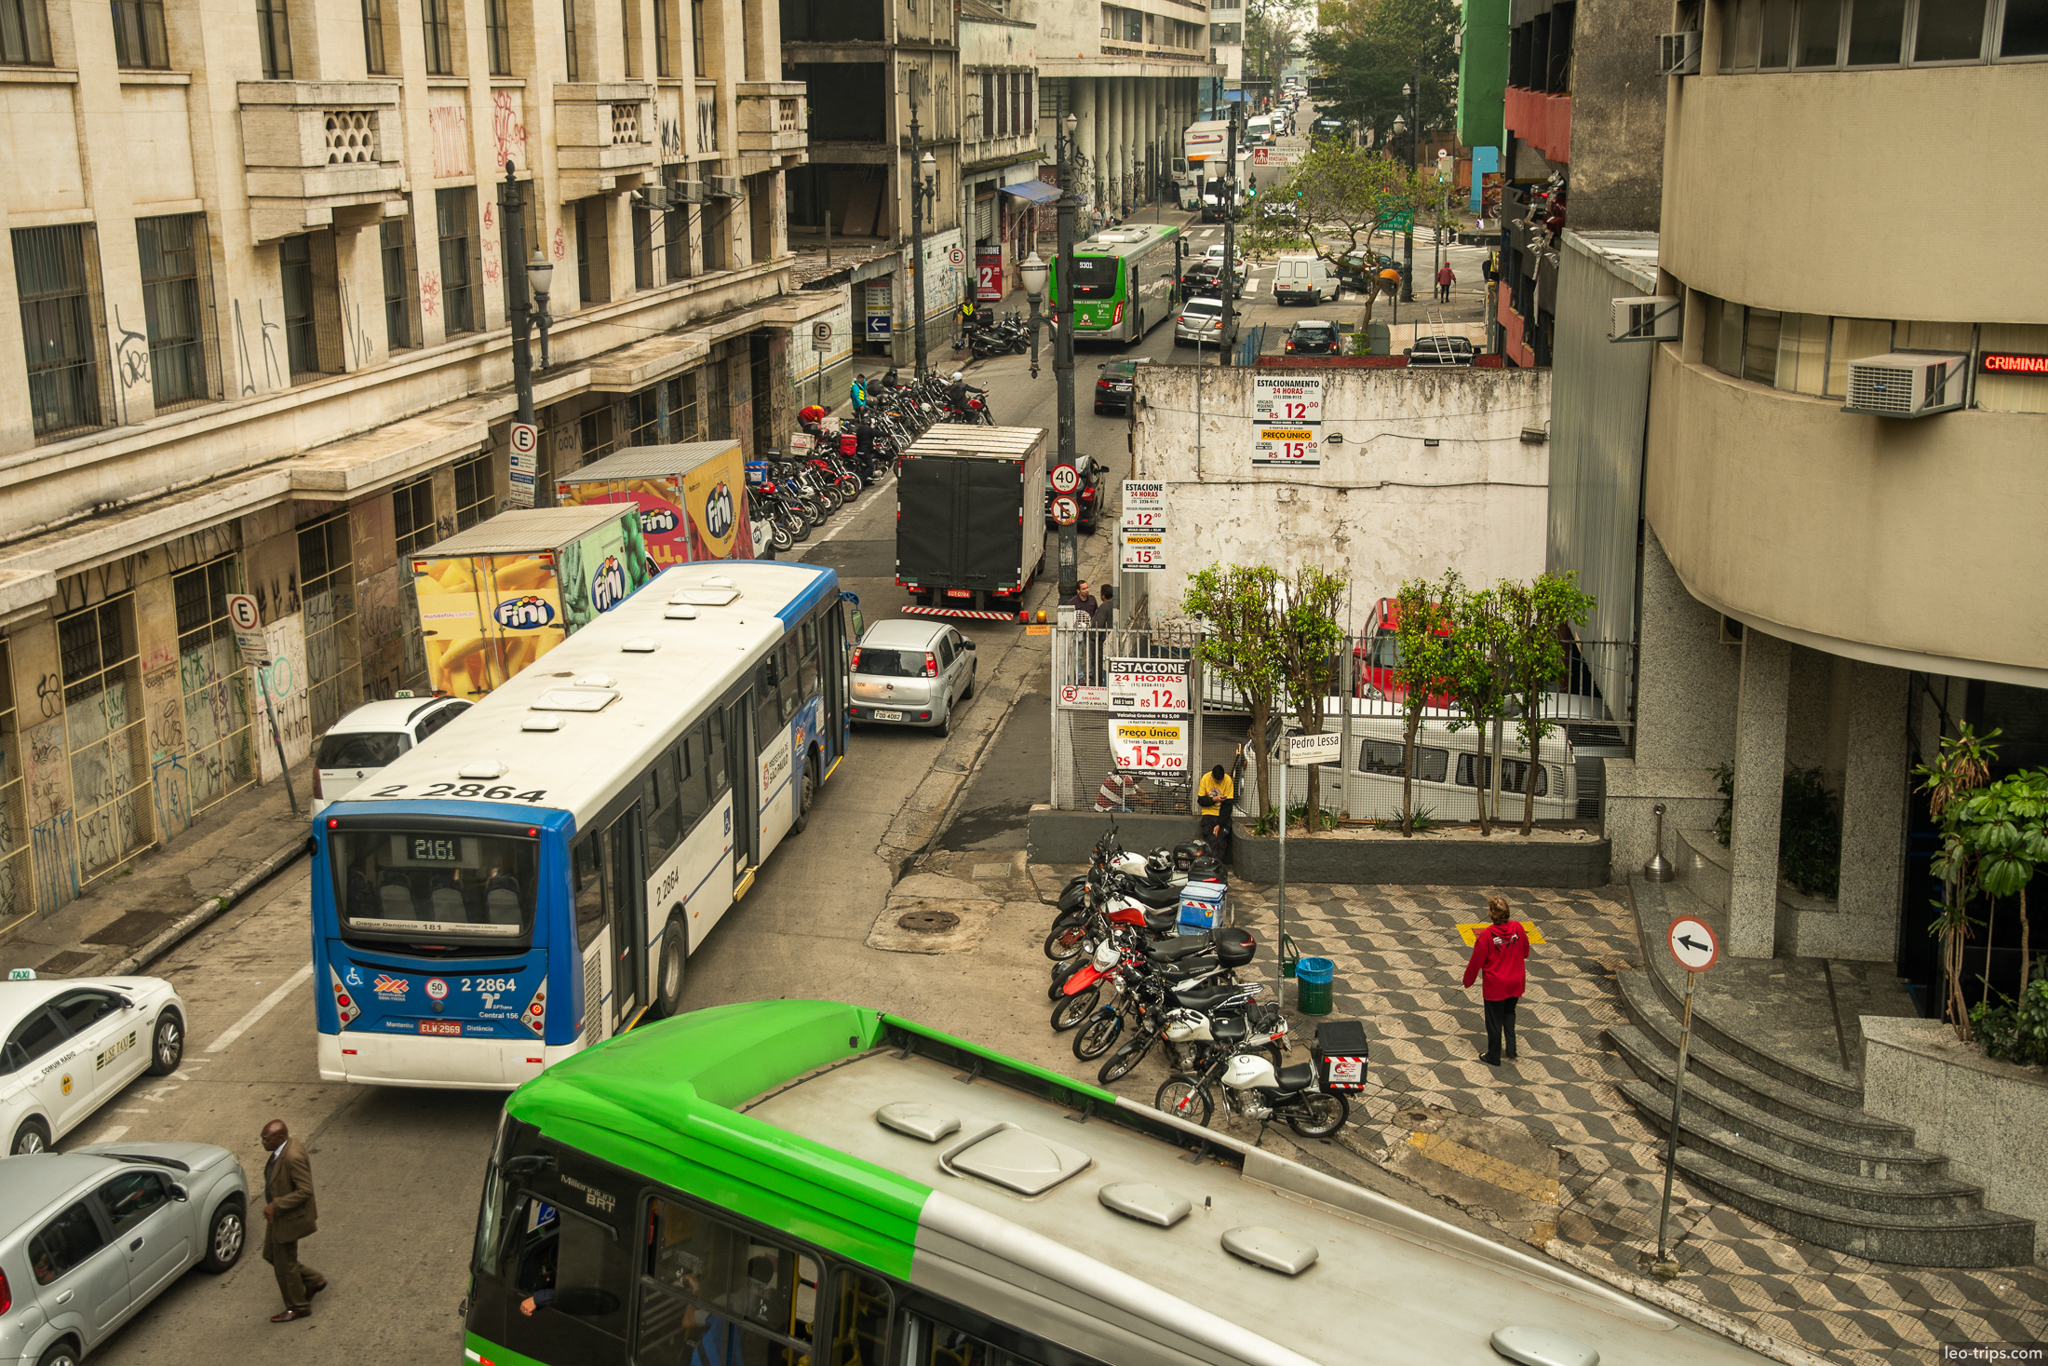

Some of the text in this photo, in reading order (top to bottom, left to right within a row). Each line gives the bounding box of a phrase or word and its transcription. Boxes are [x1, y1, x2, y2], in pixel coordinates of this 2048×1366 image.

[954, 252, 959, 261] E
[819, 326, 826, 337] E
[1257, 380, 1320, 388] ESTACIONAMENTO
[520, 431, 528, 446] E
[1056, 471, 1074, 483] 40
[238, 604, 250, 622] E
[424, 611, 476, 620] mundofini.com.br
[500, 596, 549, 627] Fini
[1111, 662, 1185, 673] ESTACIONE
[1141, 690, 1185, 709] R$ 12,00
[1119, 727, 1178, 738] Preço Único
[1292, 736, 1339, 749] Pedro Lessa
[1117, 746, 1182, 768] R$ 15,00
[370, 783, 548, 802] 2 2864
[415, 839, 455, 860] 2161
[657, 866, 679, 907] 2 2864
[12, 970, 29, 979] TAXI
[432, 983, 443, 991] 50
[461, 978, 517, 992] 2 2864
[421, 1024, 461, 1034] ELW-2969
[104, 1050, 116, 1062] USE
[115, 1037, 130, 1056] TAXI
[42, 1051, 76, 1075] COMUM RÁDIO
[561, 1174, 616, 1204] Millennium
[586, 1193, 615, 1212] BRT
